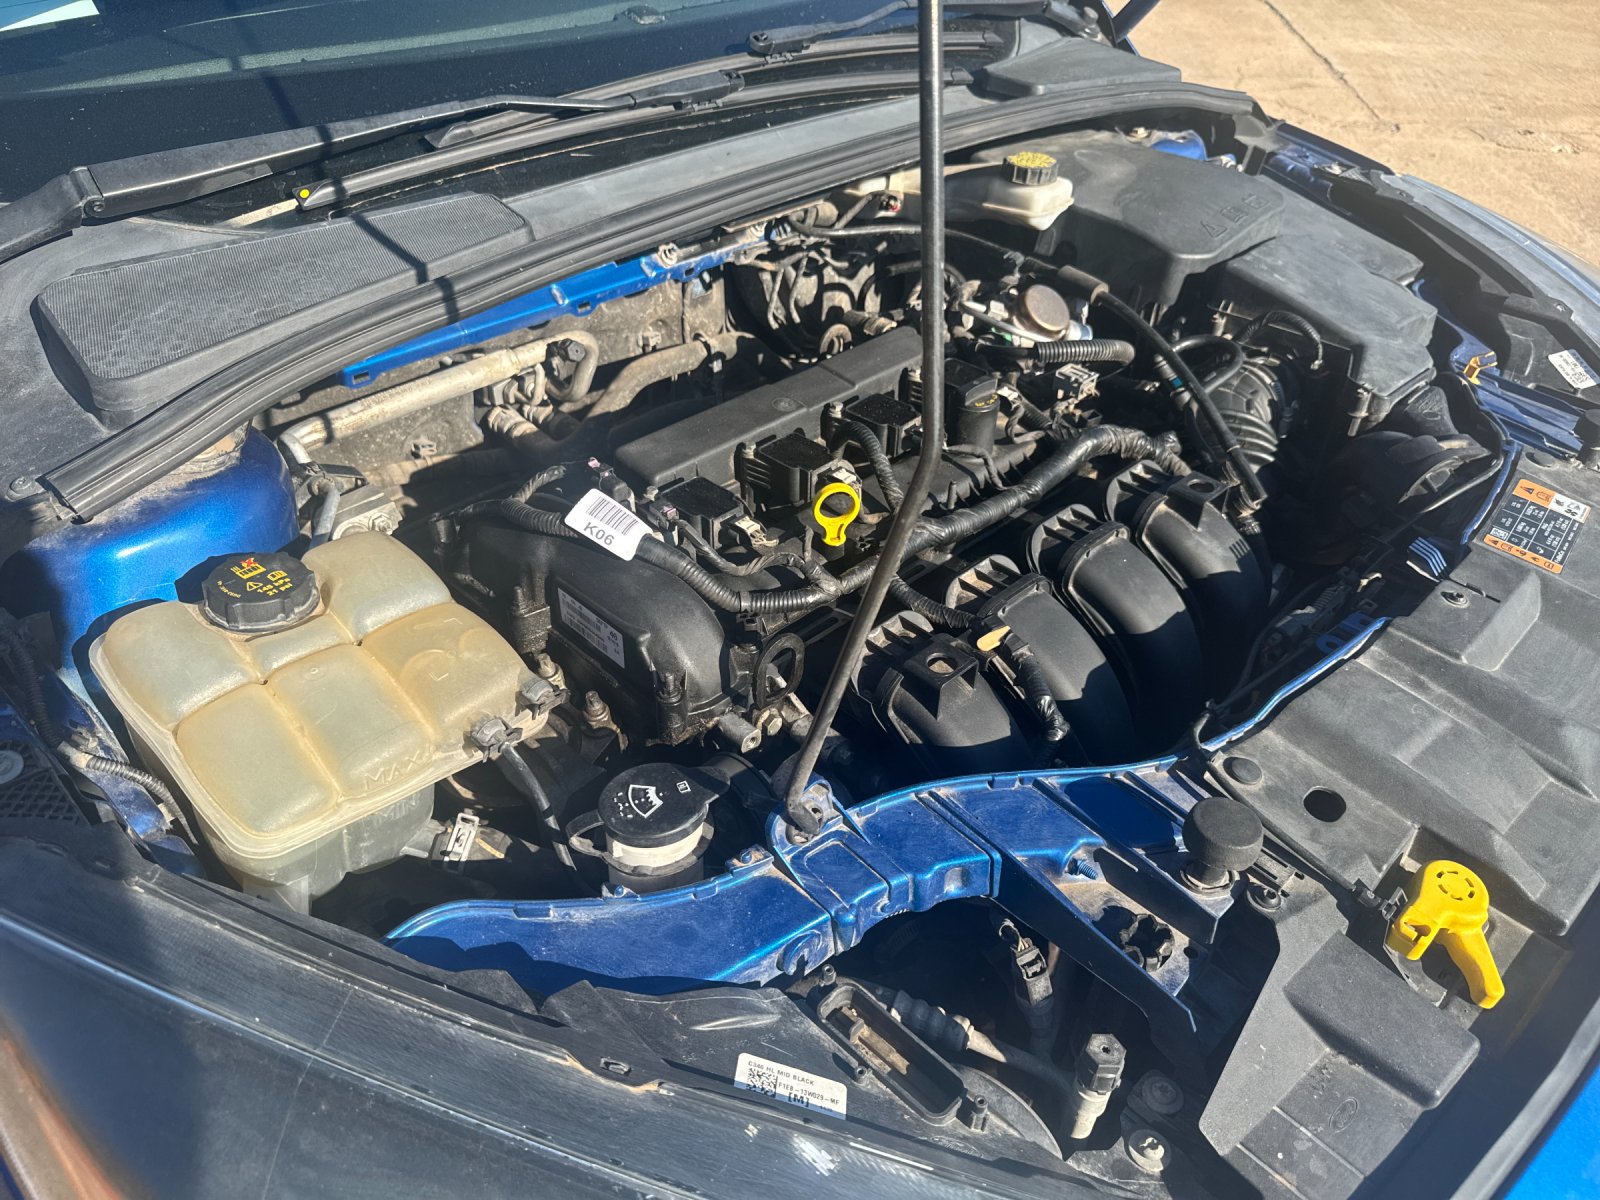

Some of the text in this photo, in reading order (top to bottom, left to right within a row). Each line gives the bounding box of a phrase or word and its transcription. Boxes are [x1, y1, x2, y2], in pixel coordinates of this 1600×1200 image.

[583, 522, 615, 546] K06
[363, 750, 421, 790] MAX
[766, 1066, 775, 1074] HL
[777, 1069, 791, 1079] MID
[792, 1075, 815, 1086] BLACK
